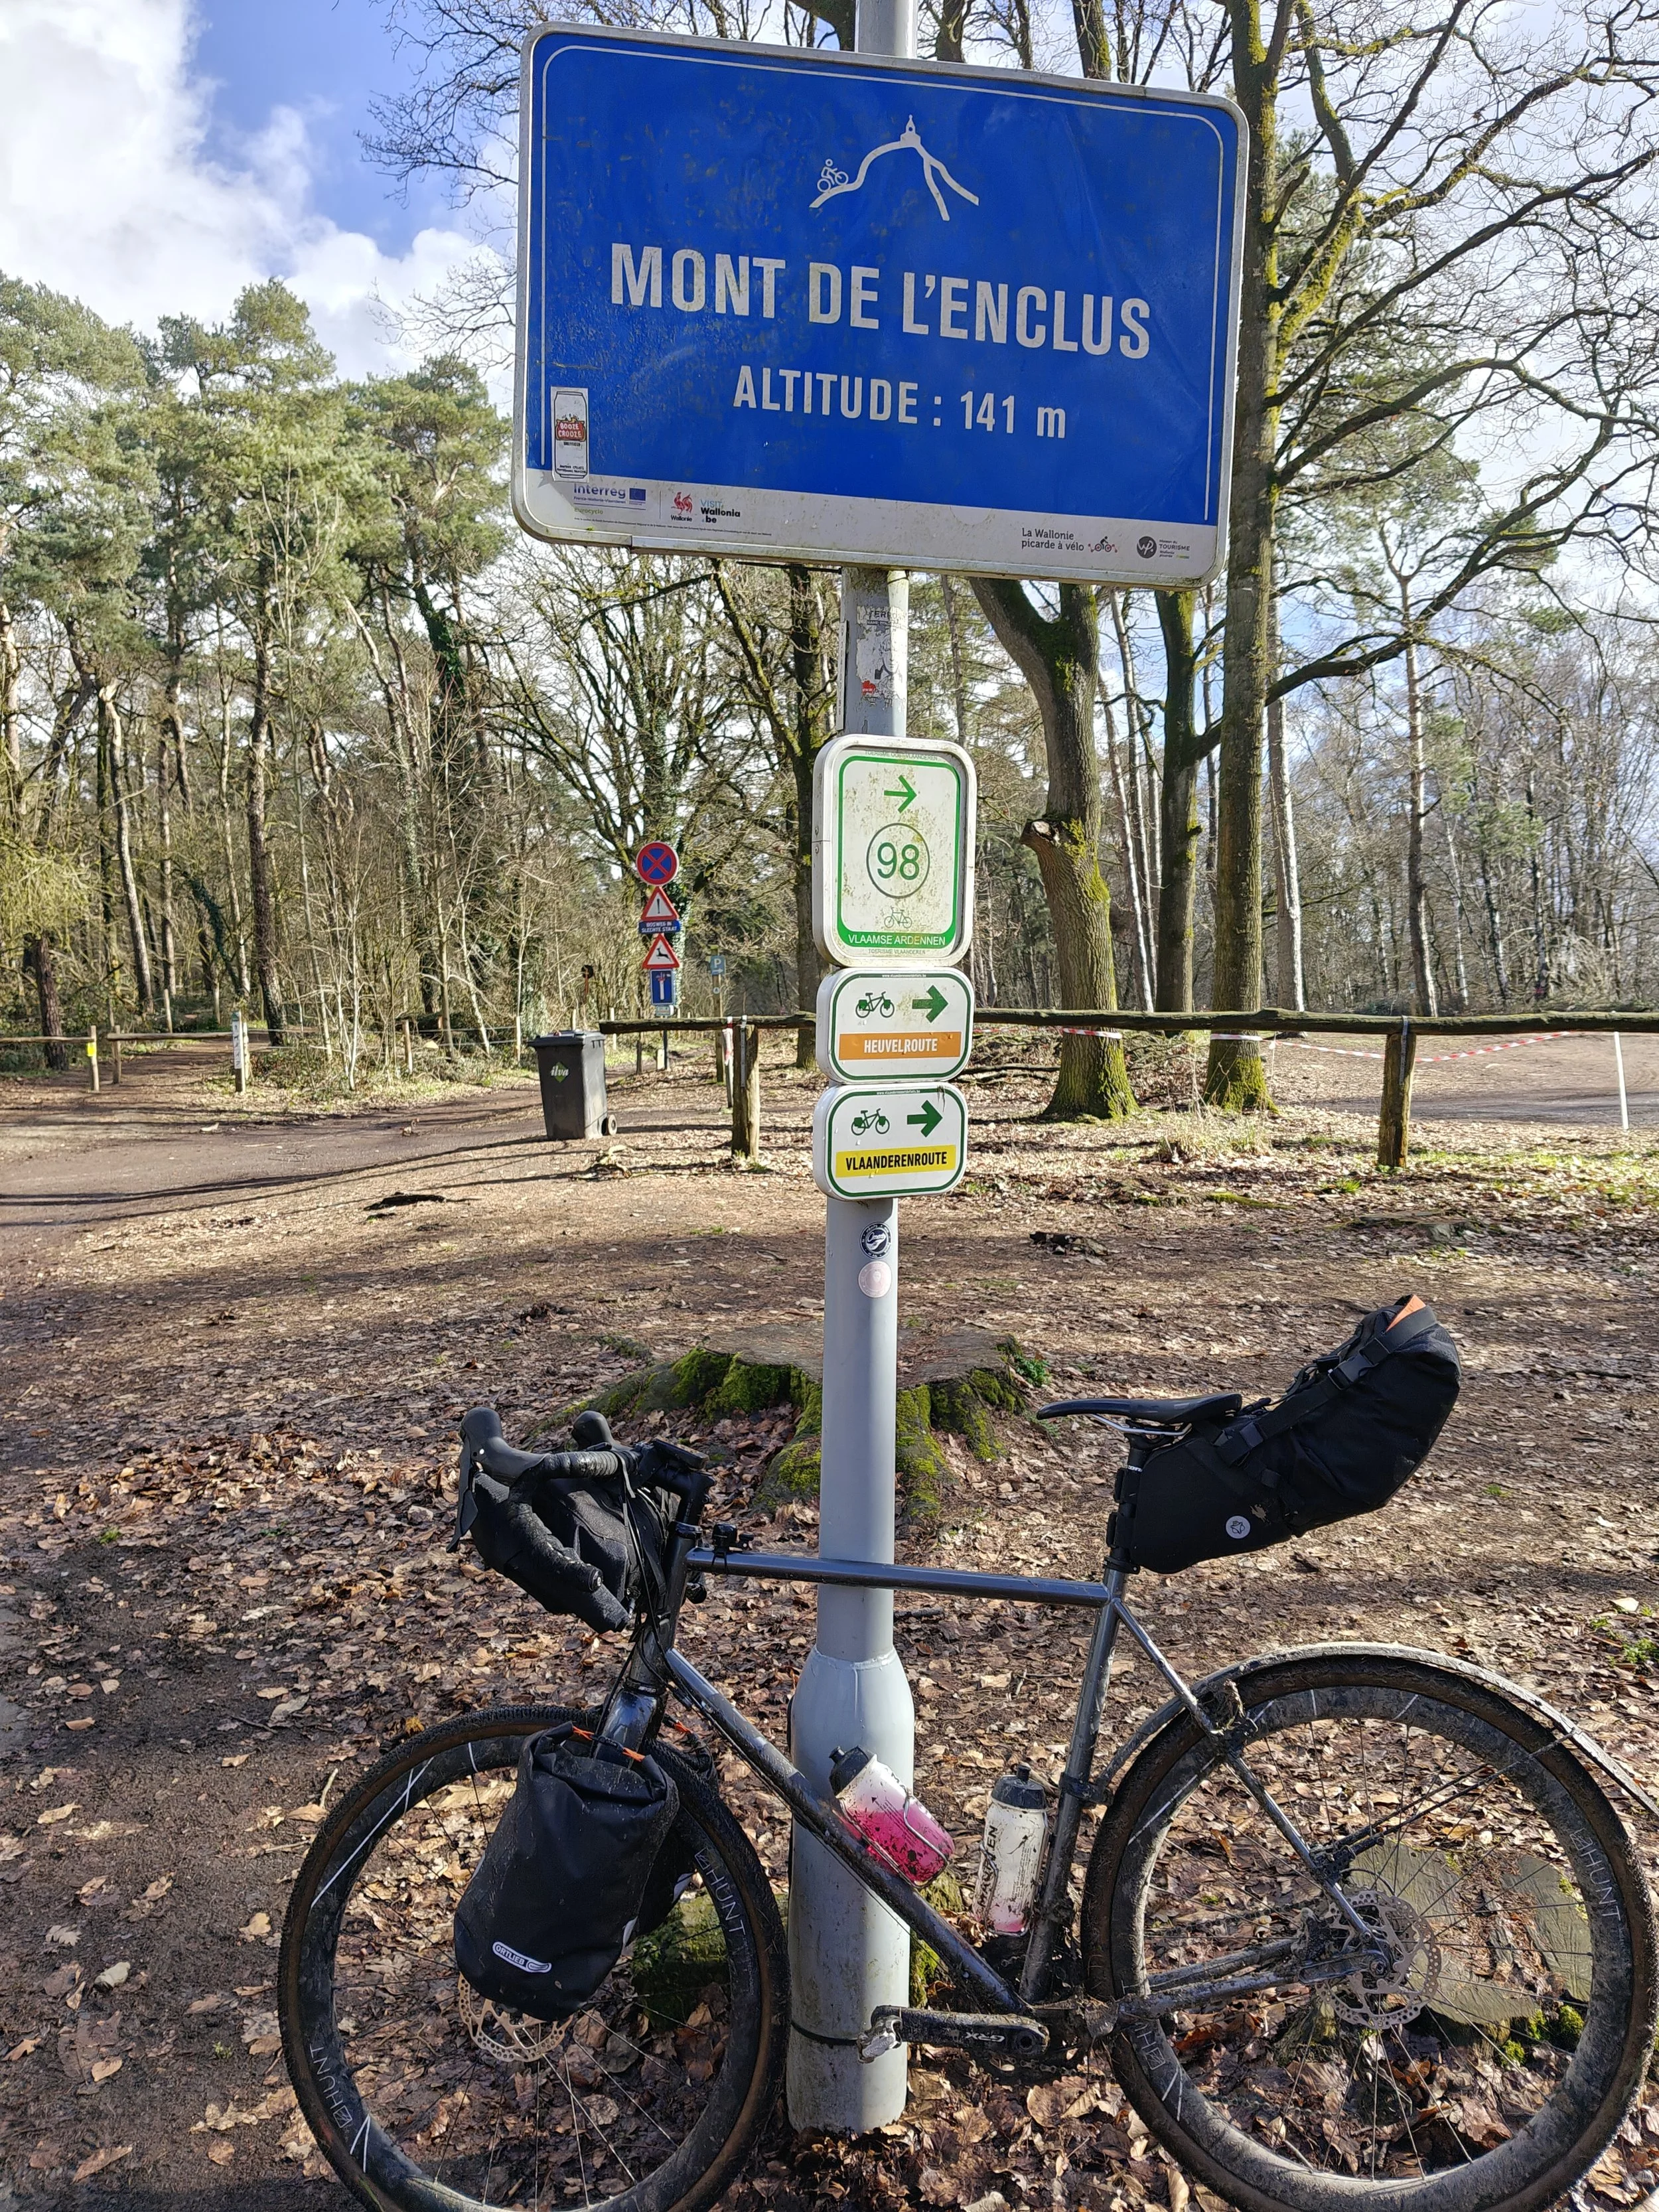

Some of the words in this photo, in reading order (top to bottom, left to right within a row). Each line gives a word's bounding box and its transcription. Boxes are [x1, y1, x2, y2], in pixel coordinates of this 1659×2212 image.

[612, 244, 785, 318] MONT
[809, 262, 879, 329] DE
[903, 272, 1149, 358] L'ENCLUS
[733, 366, 918, 423] ALTITUDE
[961, 391, 1014, 433] 141
[1037, 407, 1065, 438] m
[573, 483, 626, 499] Interreg
[701, 499, 723, 508] VISIT
[701, 507, 741, 518] Wallonia
[1022, 528, 1032, 538] La
[1035, 529, 1074, 540] Wallonie
[1021, 538, 1055, 550] picarde
[1058, 541, 1063, 550] à
[1066, 541, 1084, 551] vélo
[877, 842, 920, 881] 98
[848, 934, 893, 944] VLAAMSE
[894, 935, 946, 945] ARDENNEN
[713, 958, 721, 968] P
[864, 1038, 938, 1053] HEUVELROUTE
[550, 1065, 569, 1077] ilva
[845, 1151, 947, 1171] VLAANDERENROUTE
[1580, 1848, 1621, 1921] HUNT
[706, 1869, 747, 1936] HUNT
[496, 1945, 525, 1965] ORTLIEB
[965, 2031, 1005, 2043] GRX
[309, 2043, 343, 2109] HUNT
